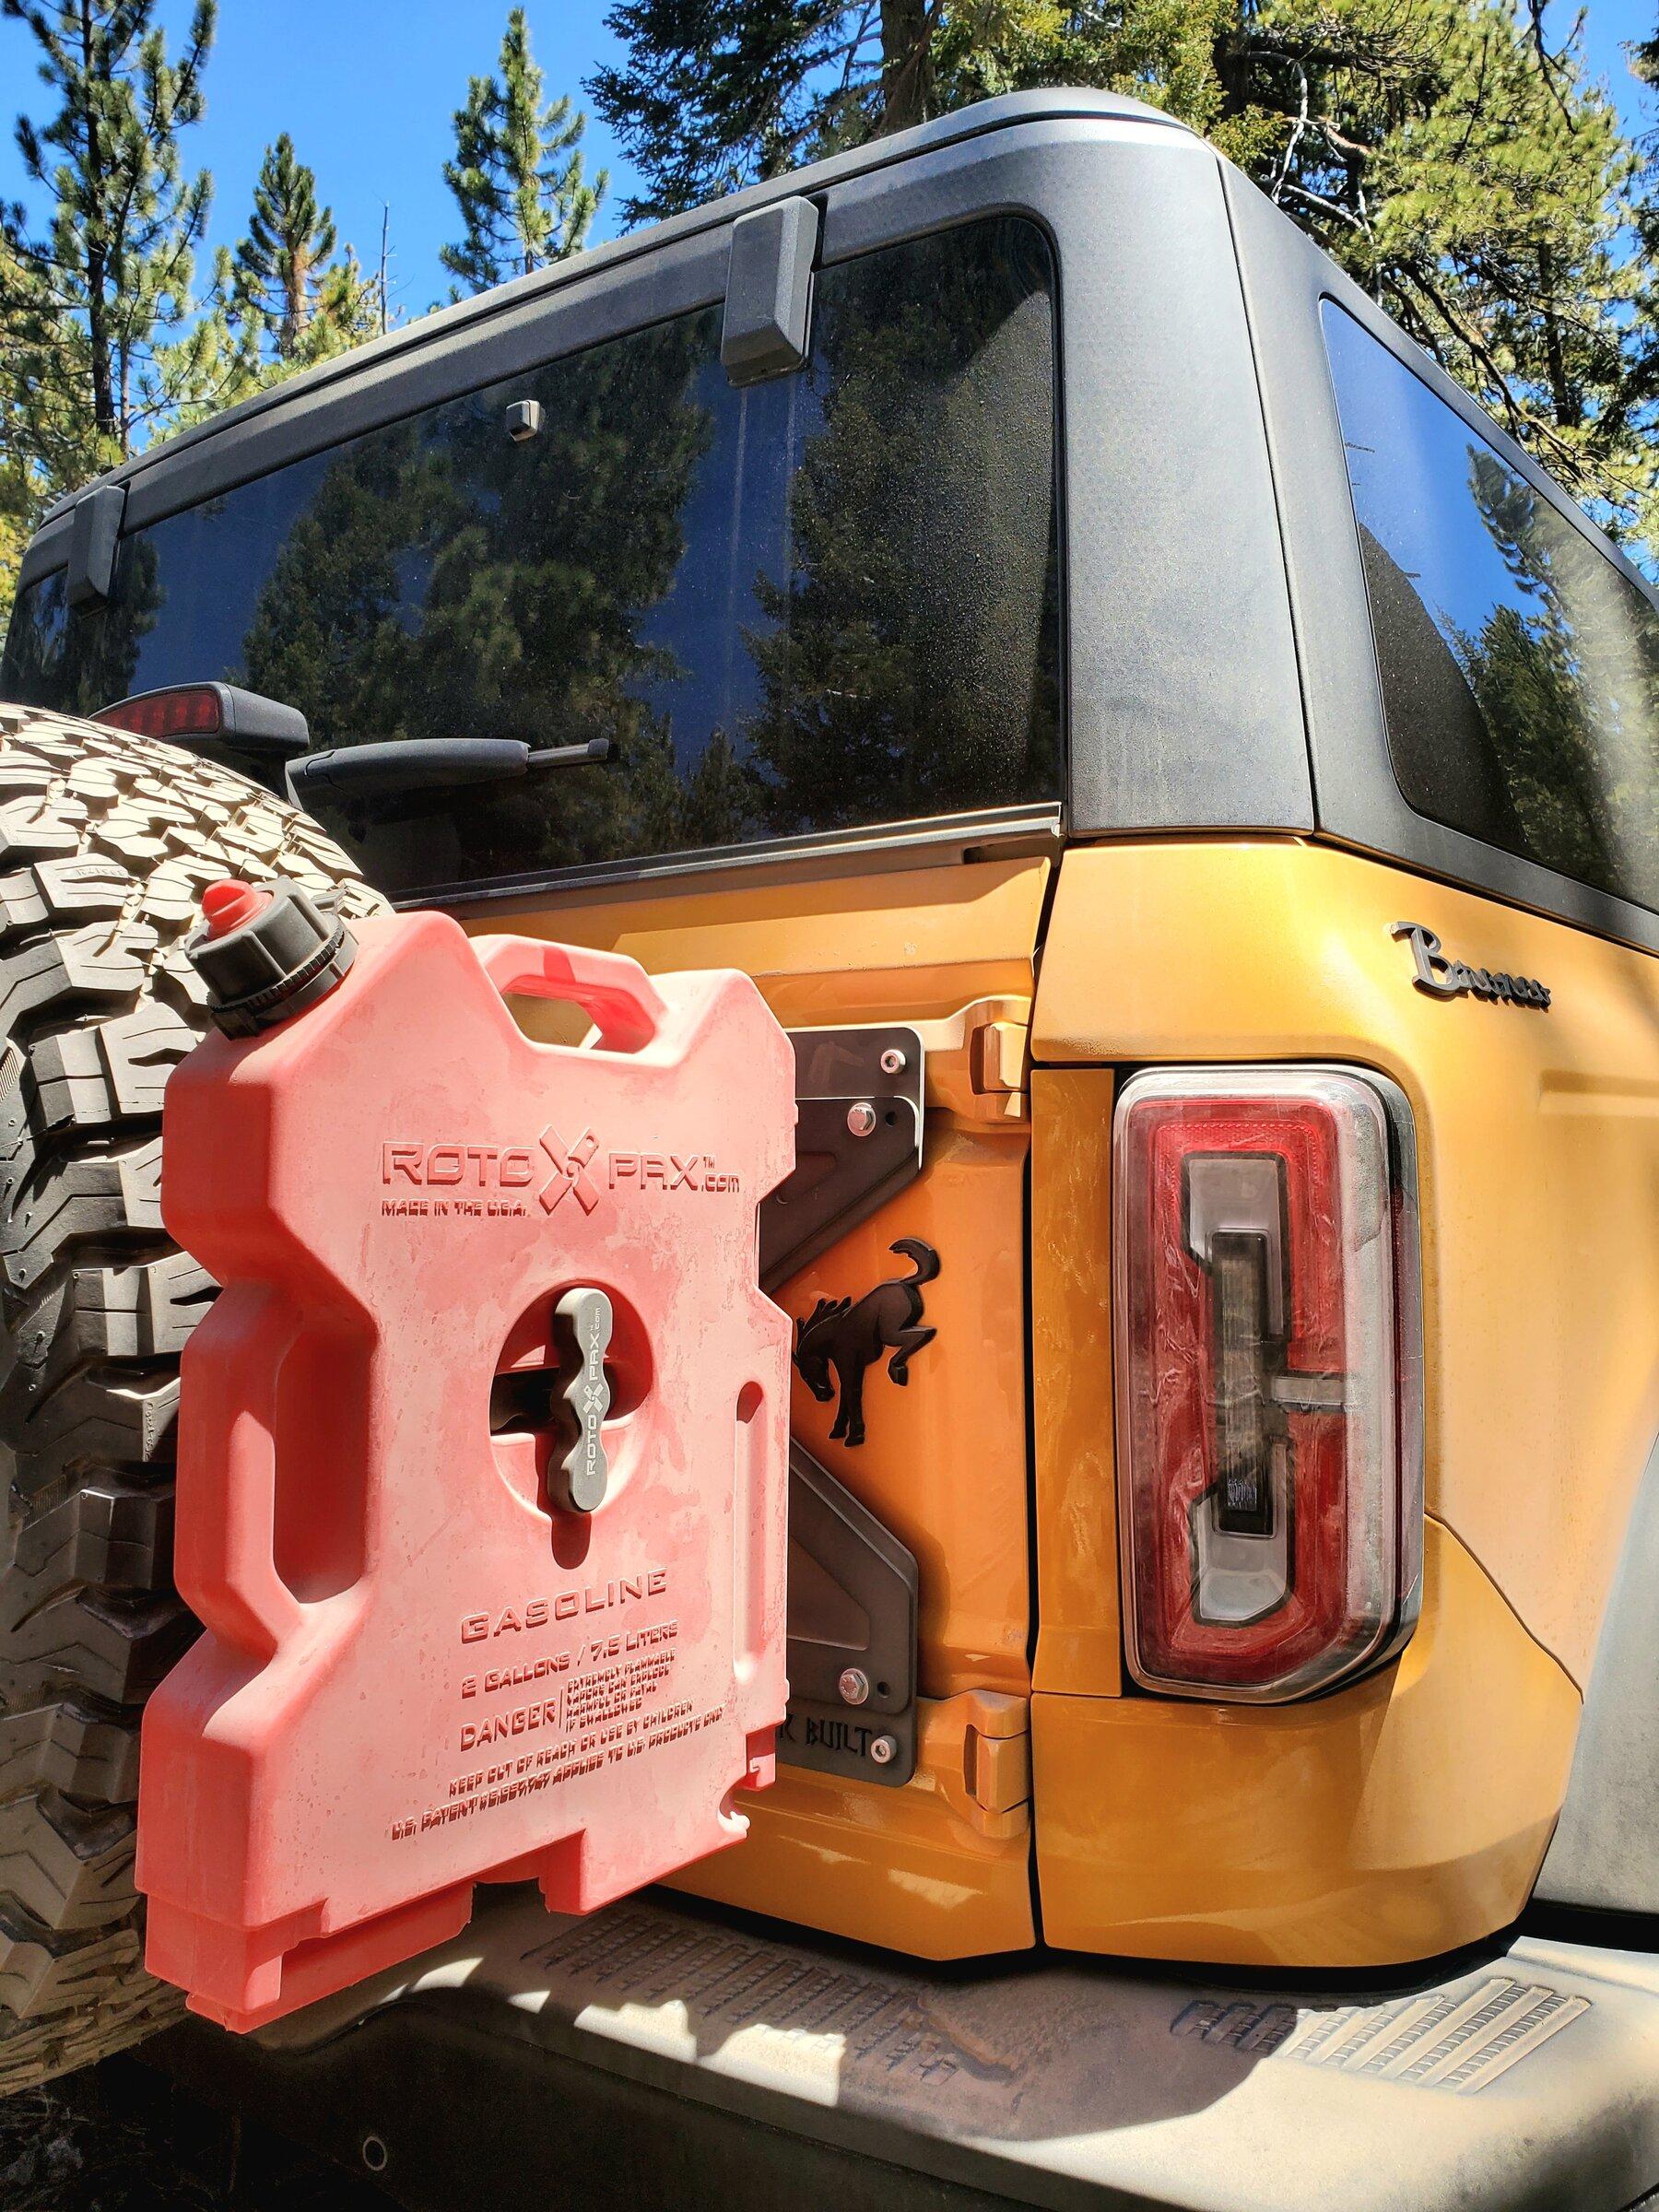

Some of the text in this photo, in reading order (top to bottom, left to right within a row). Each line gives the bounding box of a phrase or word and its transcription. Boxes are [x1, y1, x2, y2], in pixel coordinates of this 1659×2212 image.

[382, 1140, 535, 1187] ROTO
[381, 1197, 429, 1217] MADE
[434, 1197, 448, 1217] IN
[453, 1197, 482, 1217] THE
[586, 1415, 597, 1476] ROTO
[461, 1568, 668, 1644] GASOLINE
[461, 1674, 477, 1700] 2
[484, 1651, 571, 1693] GALLONS
[626, 1619, 679, 1652] LITERS
[460, 1697, 556, 1752] DANGER
[806, 1717, 874, 1758] BUILT
[449, 1770, 484, 1798] KEEP
[487, 1759, 513, 1784] OUT
[516, 1753, 535, 1774] OF
